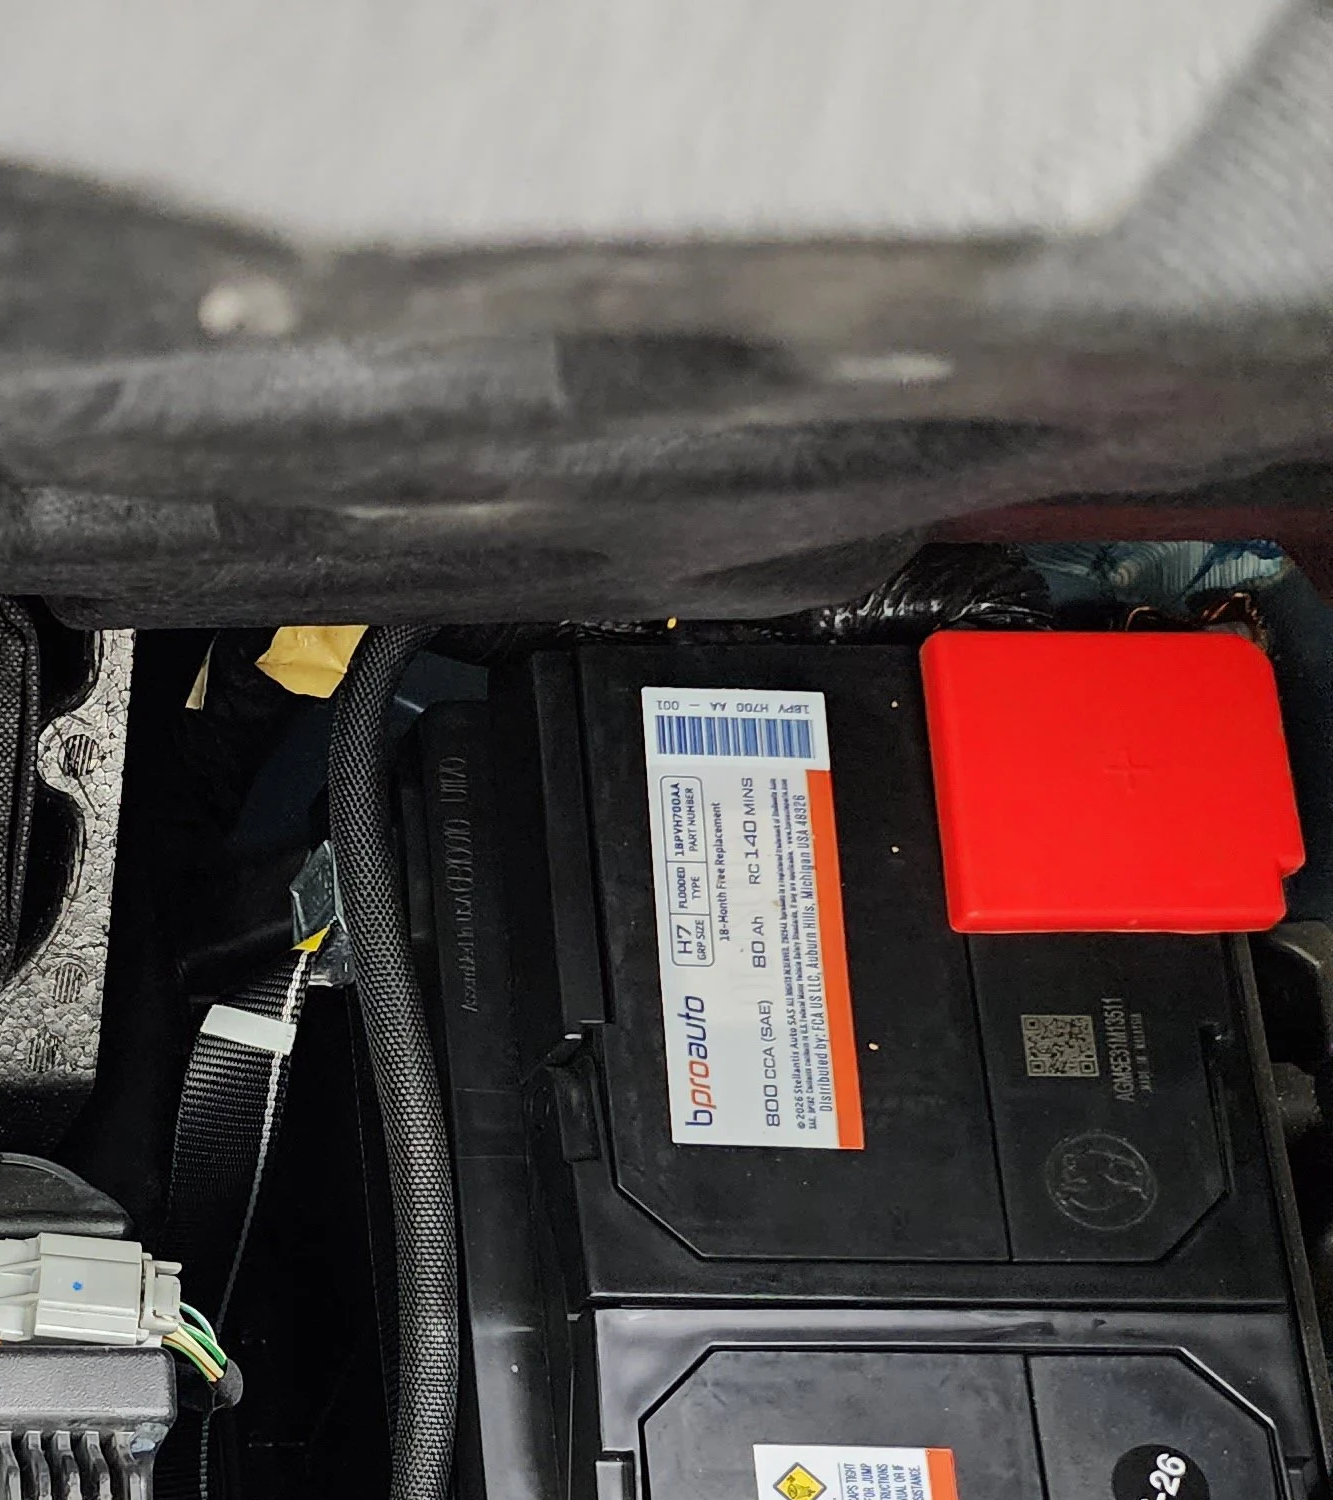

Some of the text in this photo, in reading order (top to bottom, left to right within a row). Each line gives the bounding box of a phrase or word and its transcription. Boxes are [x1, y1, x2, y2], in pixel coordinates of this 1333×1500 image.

[656, 700, 680, 711] 001
[709, 701, 728, 712] AA
[736, 702, 769, 713] H700
[684, 787, 697, 851] PART NUMBER
[740, 777, 760, 884] RC 140 MINS
[709, 801, 730, 941] 18-Month Free Replacement
[676, 866, 688, 908] FLOODED
[690, 876, 701, 900] TYPE
[675, 924, 692, 954] H7
[694, 919, 706, 960] GRP SIZE
[751, 915, 766, 968] 80 Ah
[791, 794, 832, 1111] Distributed by: FCA US LLC, Auburn Hills, Michigan USA 48326
[786, 1008, 796, 1024] SAS
[788, 1027, 798, 1048] Auto
[676, 995, 718, 1126] bproauto
[757, 1000, 780, 1126] 800 CCA (SAE)
[790, 1051, 802, 1093] Stellantis
[794, 1095, 804, 1119] 2026
[844, 1462, 857, 1482] TIGHT
[860, 1463, 873, 1483] JUMP
[893, 1472, 906, 1482] OR
[863, 1487, 875, 1500] FOR
